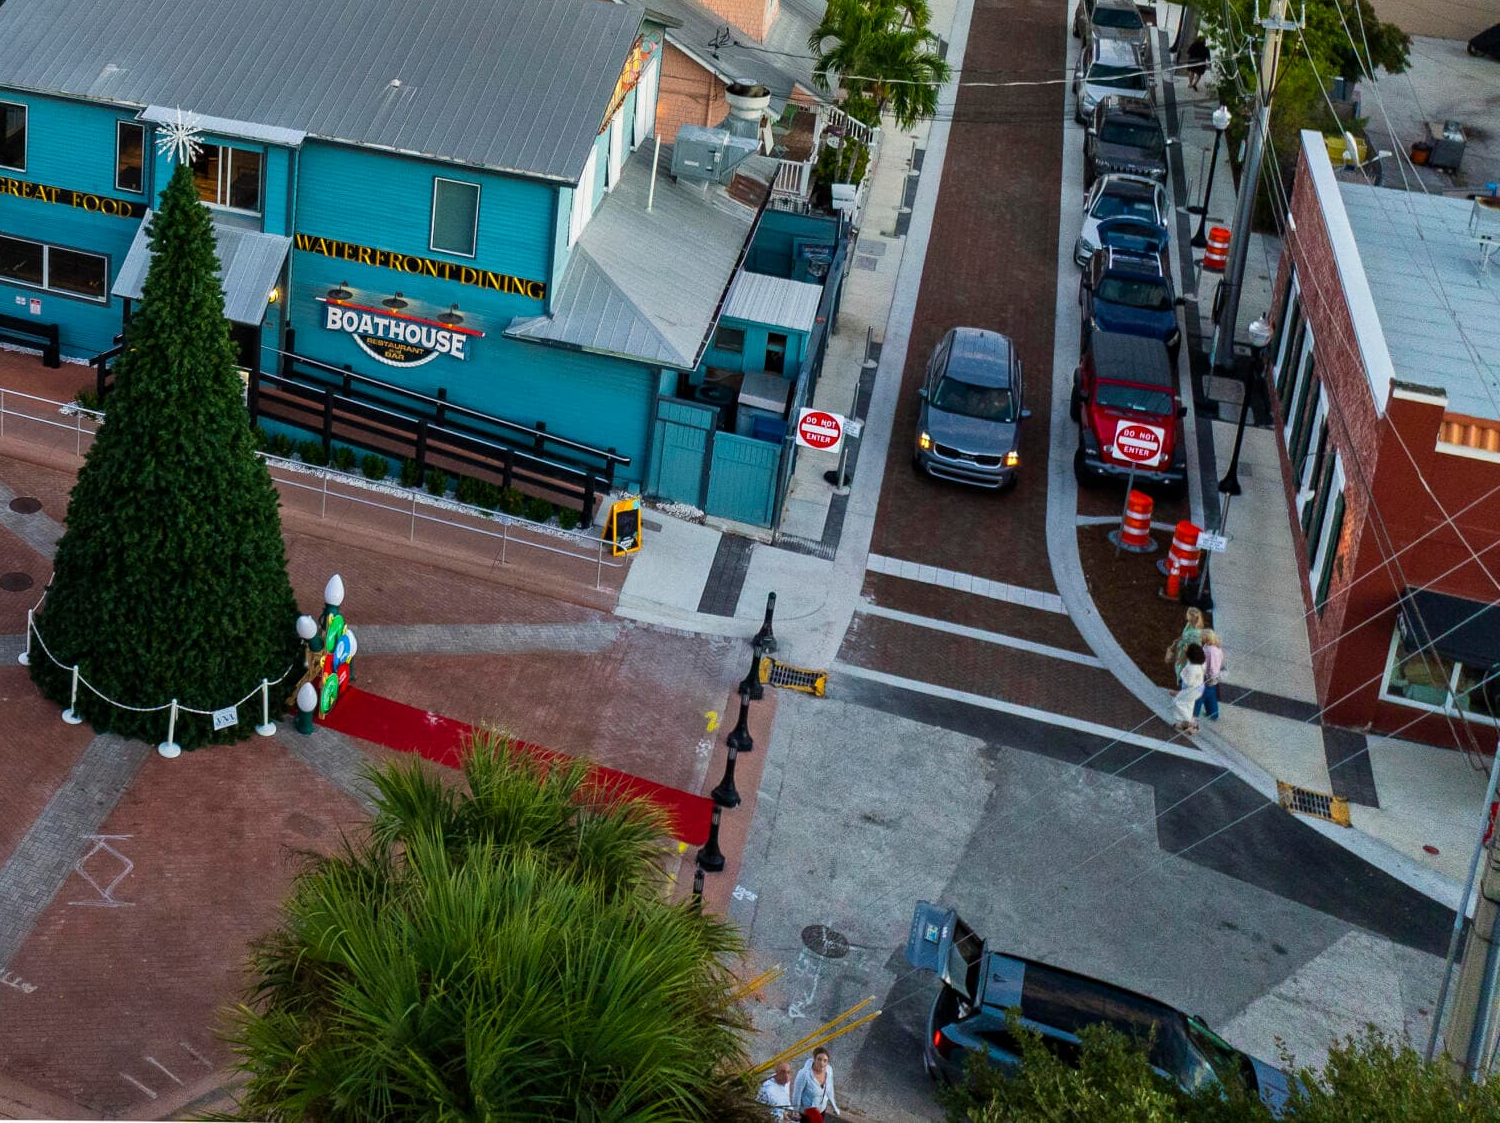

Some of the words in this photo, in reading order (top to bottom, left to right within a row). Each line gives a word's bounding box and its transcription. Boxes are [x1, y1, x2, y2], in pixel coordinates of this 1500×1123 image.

[72, 191, 132, 218] FOOD
[295, 232, 457, 282] WATERFRONT
[459, 267, 545, 300] DINING
[326, 306, 467, 361] BOATHOUSE
[366, 337, 425, 355] RESTAURANT
[384, 351, 405, 361] BAR
[806, 416, 817, 425] DO
[821, 419, 837, 428] NOT
[806, 433, 831, 443] ENTER
[1123, 428, 1135, 437] DO
[1140, 431, 1155, 441] NOT
[1123, 445, 1150, 457] ENTER
